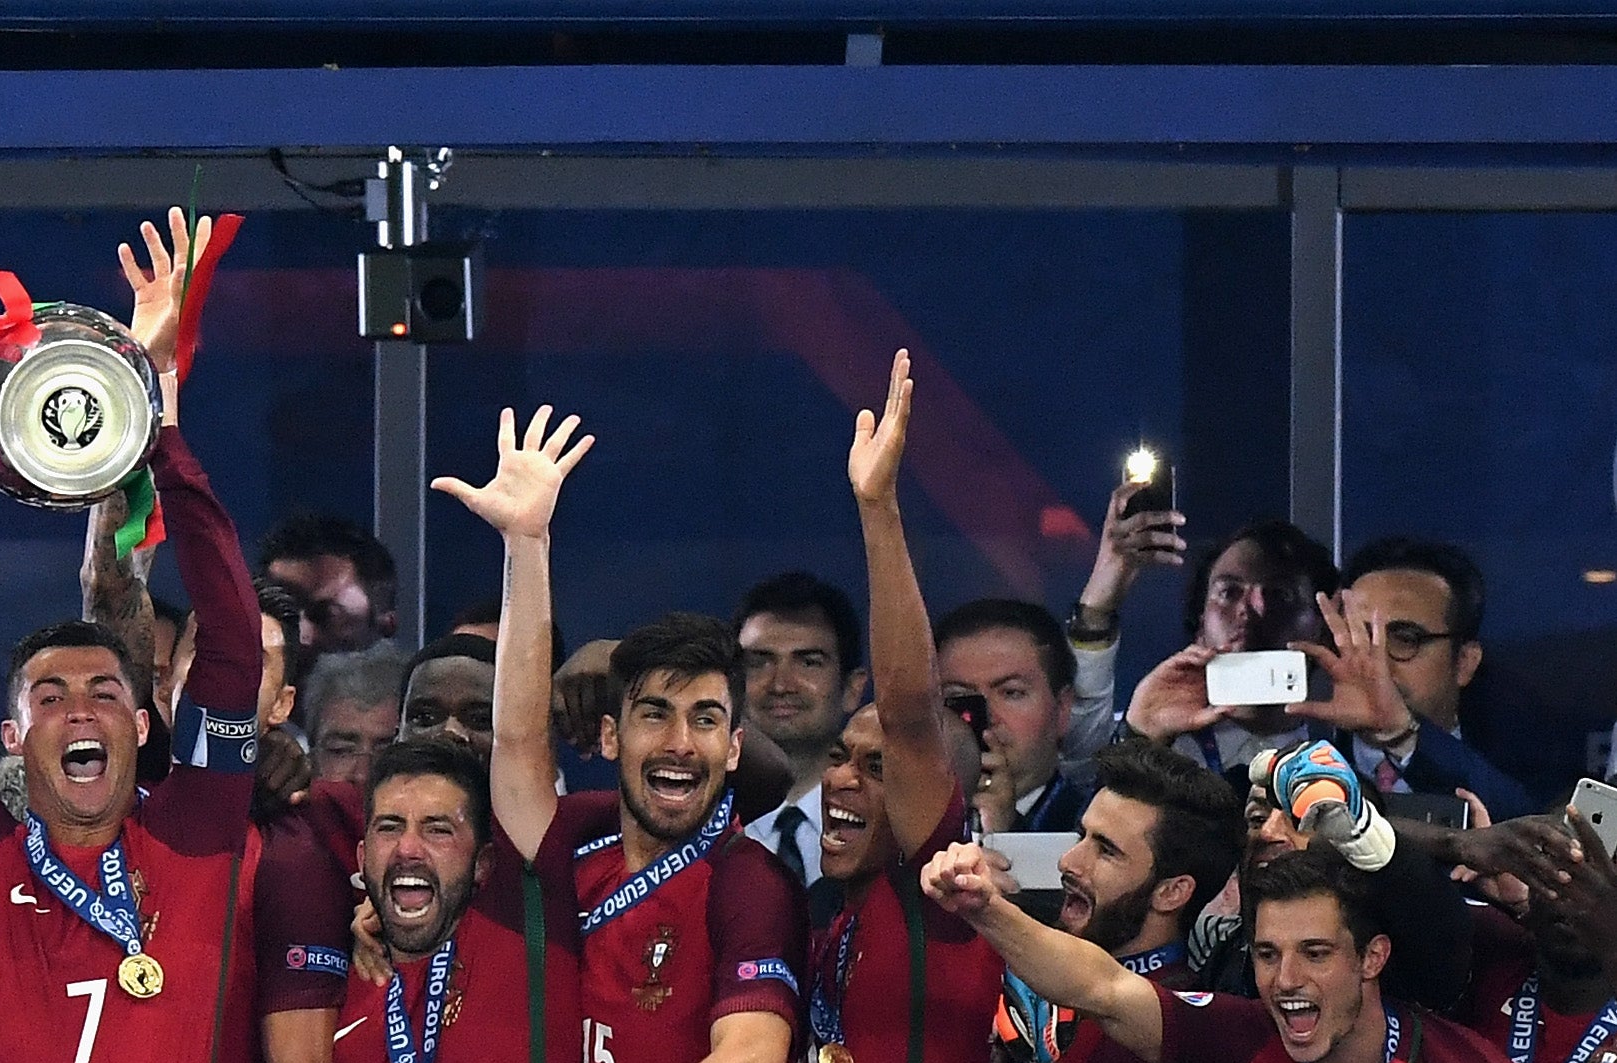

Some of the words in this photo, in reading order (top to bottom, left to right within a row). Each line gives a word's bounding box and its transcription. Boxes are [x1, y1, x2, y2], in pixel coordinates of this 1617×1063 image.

[206, 720, 253, 735] RACISM
[41, 858, 88, 907] UEFA
[102, 849, 126, 896] 2016
[646, 844, 698, 885] UEFA
[603, 876, 648, 916] EURO
[1123, 954, 1163, 974] 016
[388, 999, 409, 1049] UEFA
[424, 1000, 441, 1053] 2016
[1513, 996, 1536, 1050] EURO
